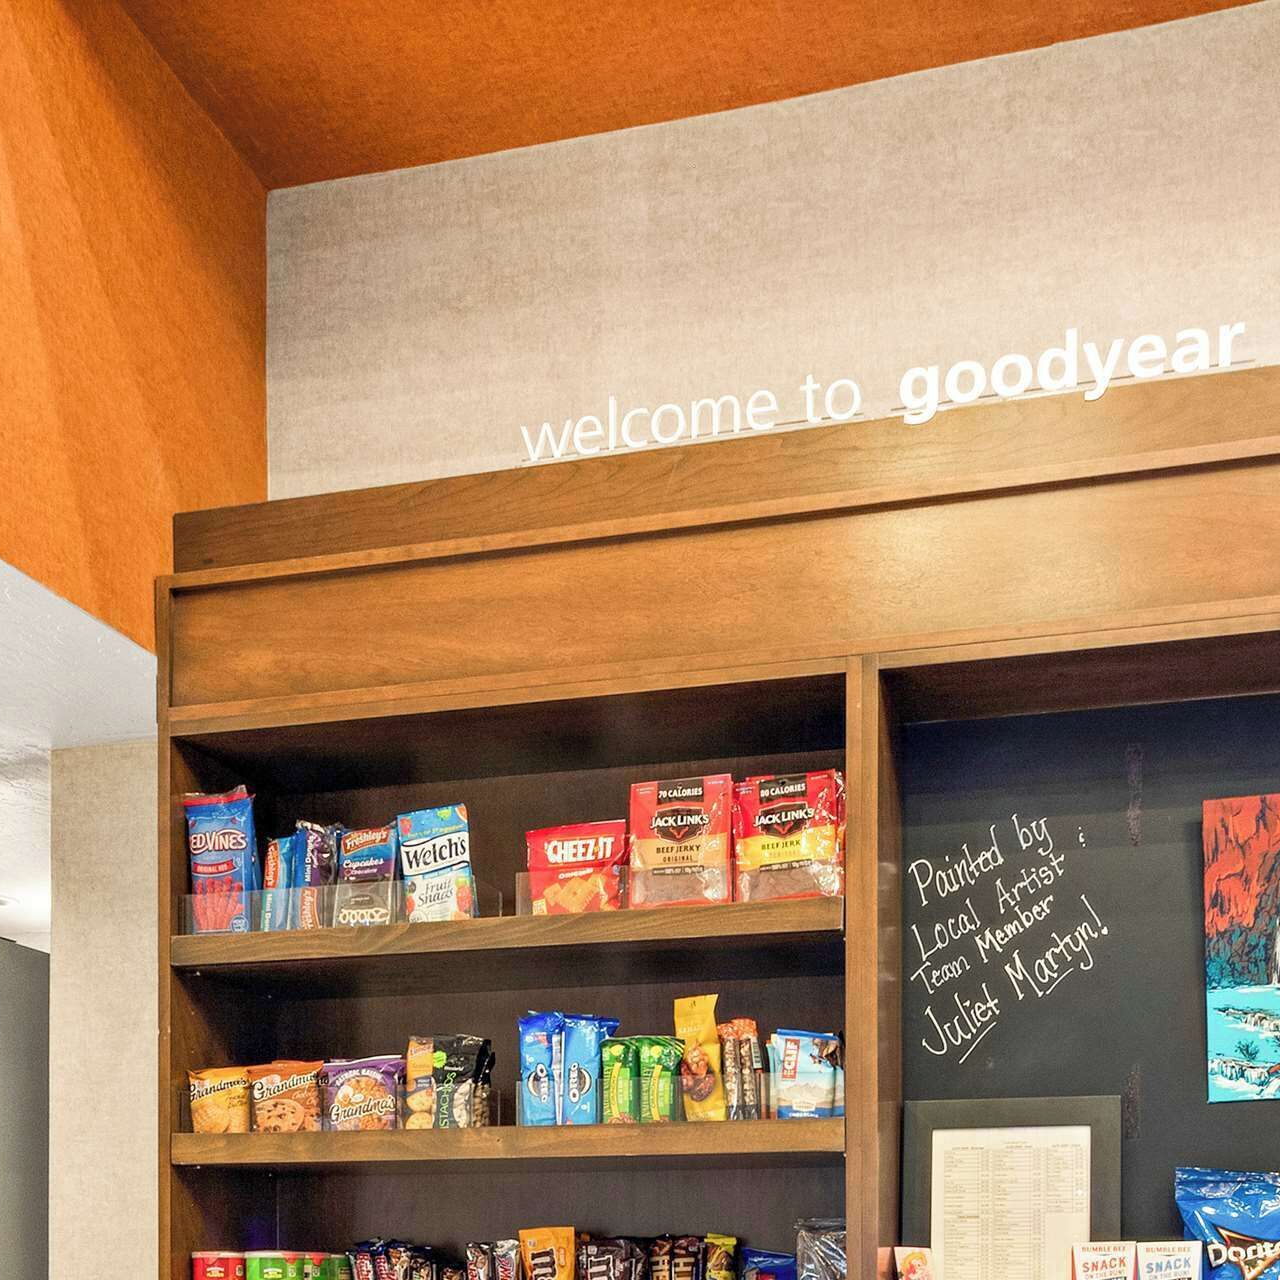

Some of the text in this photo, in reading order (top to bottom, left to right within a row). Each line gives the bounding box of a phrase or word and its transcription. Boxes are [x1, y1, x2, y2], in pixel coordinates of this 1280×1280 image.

[521, 321, 1245, 461] welcome to goodyear
[668, 786, 703, 798] CALORIES
[771, 783, 806, 797] CALORIES
[650, 813, 710, 828] JACK LINK'S
[753, 807, 814, 827] JACK LINK'S
[206, 829, 247, 851] VINES
[342, 858, 385, 868] Cupcakes
[405, 838, 467, 869] Welch's
[908, 813, 1053, 907] Painted by
[417, 888, 453, 904] Snacks
[424, 879, 452, 895] Fruit
[911, 853, 1065, 962] Local Artist
[910, 895, 1054, 995] Team Member
[922, 894, 1109, 1056] Juliet Martyn!
[783, 1040, 799, 1069] CLIF
[536, 1063, 548, 1104] OREO
[568, 1061, 580, 1103] OREO
[329, 1092, 396, 1124] Grandma's
[1082, 1257, 1127, 1273] SNACK
[1146, 1257, 1192, 1274] SNACK
